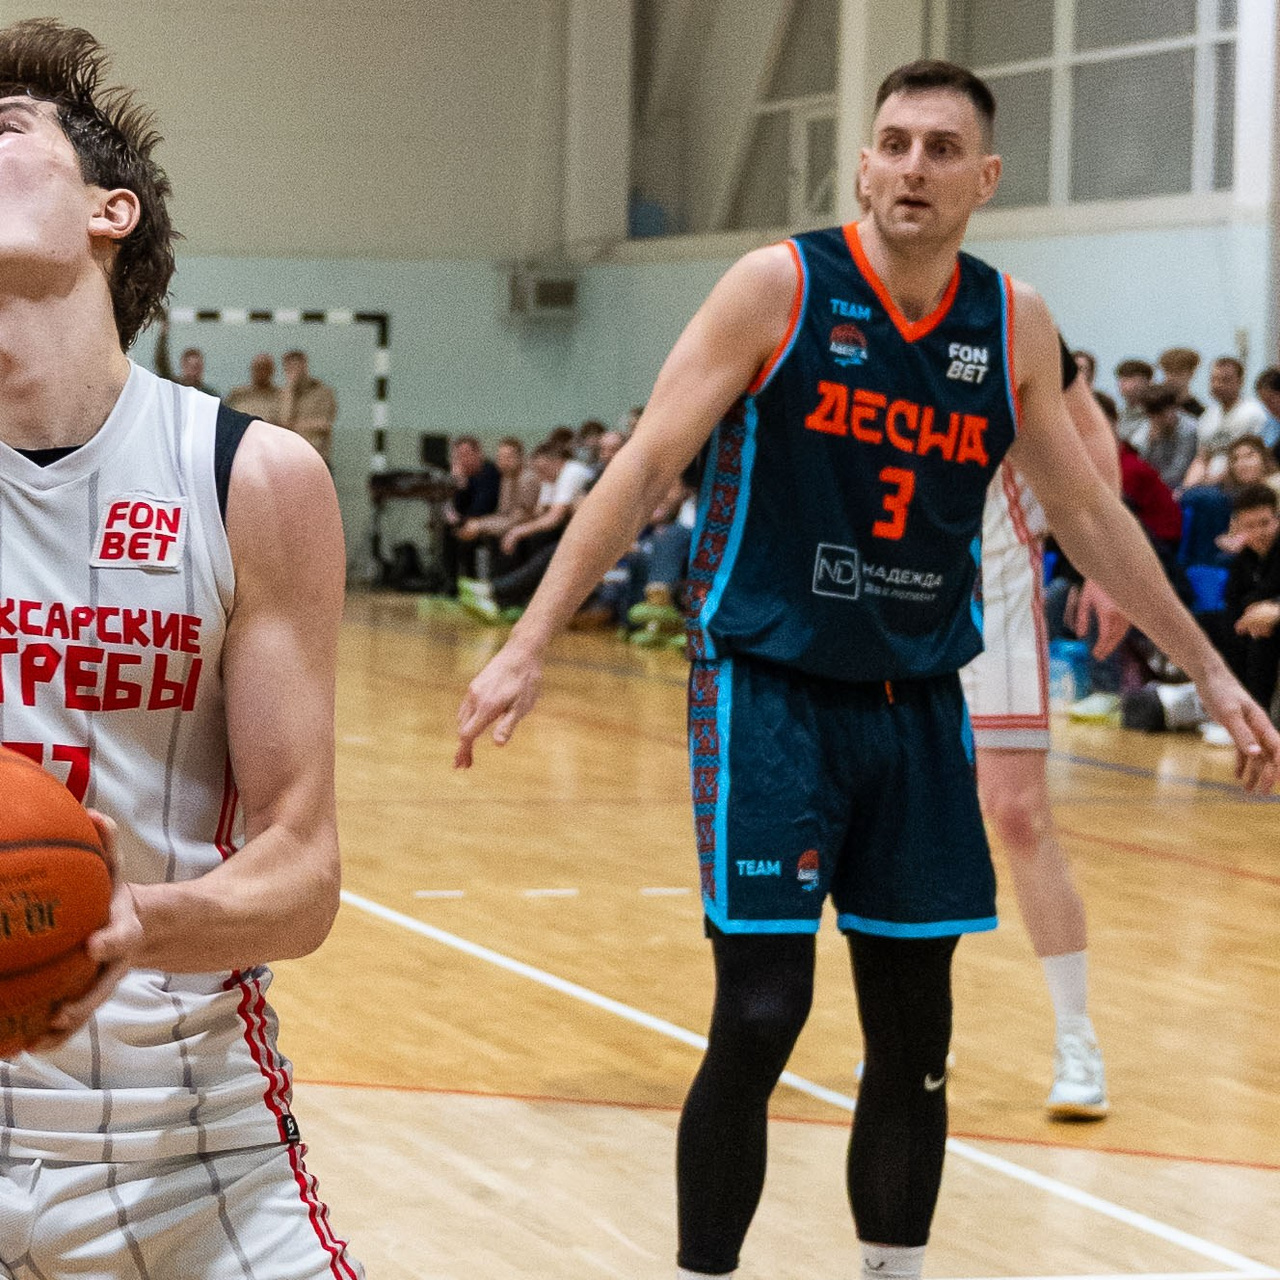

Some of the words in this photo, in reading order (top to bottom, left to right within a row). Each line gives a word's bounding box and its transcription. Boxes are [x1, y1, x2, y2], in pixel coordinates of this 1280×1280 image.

[830, 297, 870, 320] TEAM
[948, 342, 988, 363] FON
[946, 360, 989, 384] BET
[804, 379, 990, 467] ДЕСНА
[872, 466, 915, 540] 3
[105, 500, 182, 535] FON
[98, 531, 177, 562] BET
[862, 562, 944, 588] НАДЕЖДА
[735, 859, 782, 877] TEAM
